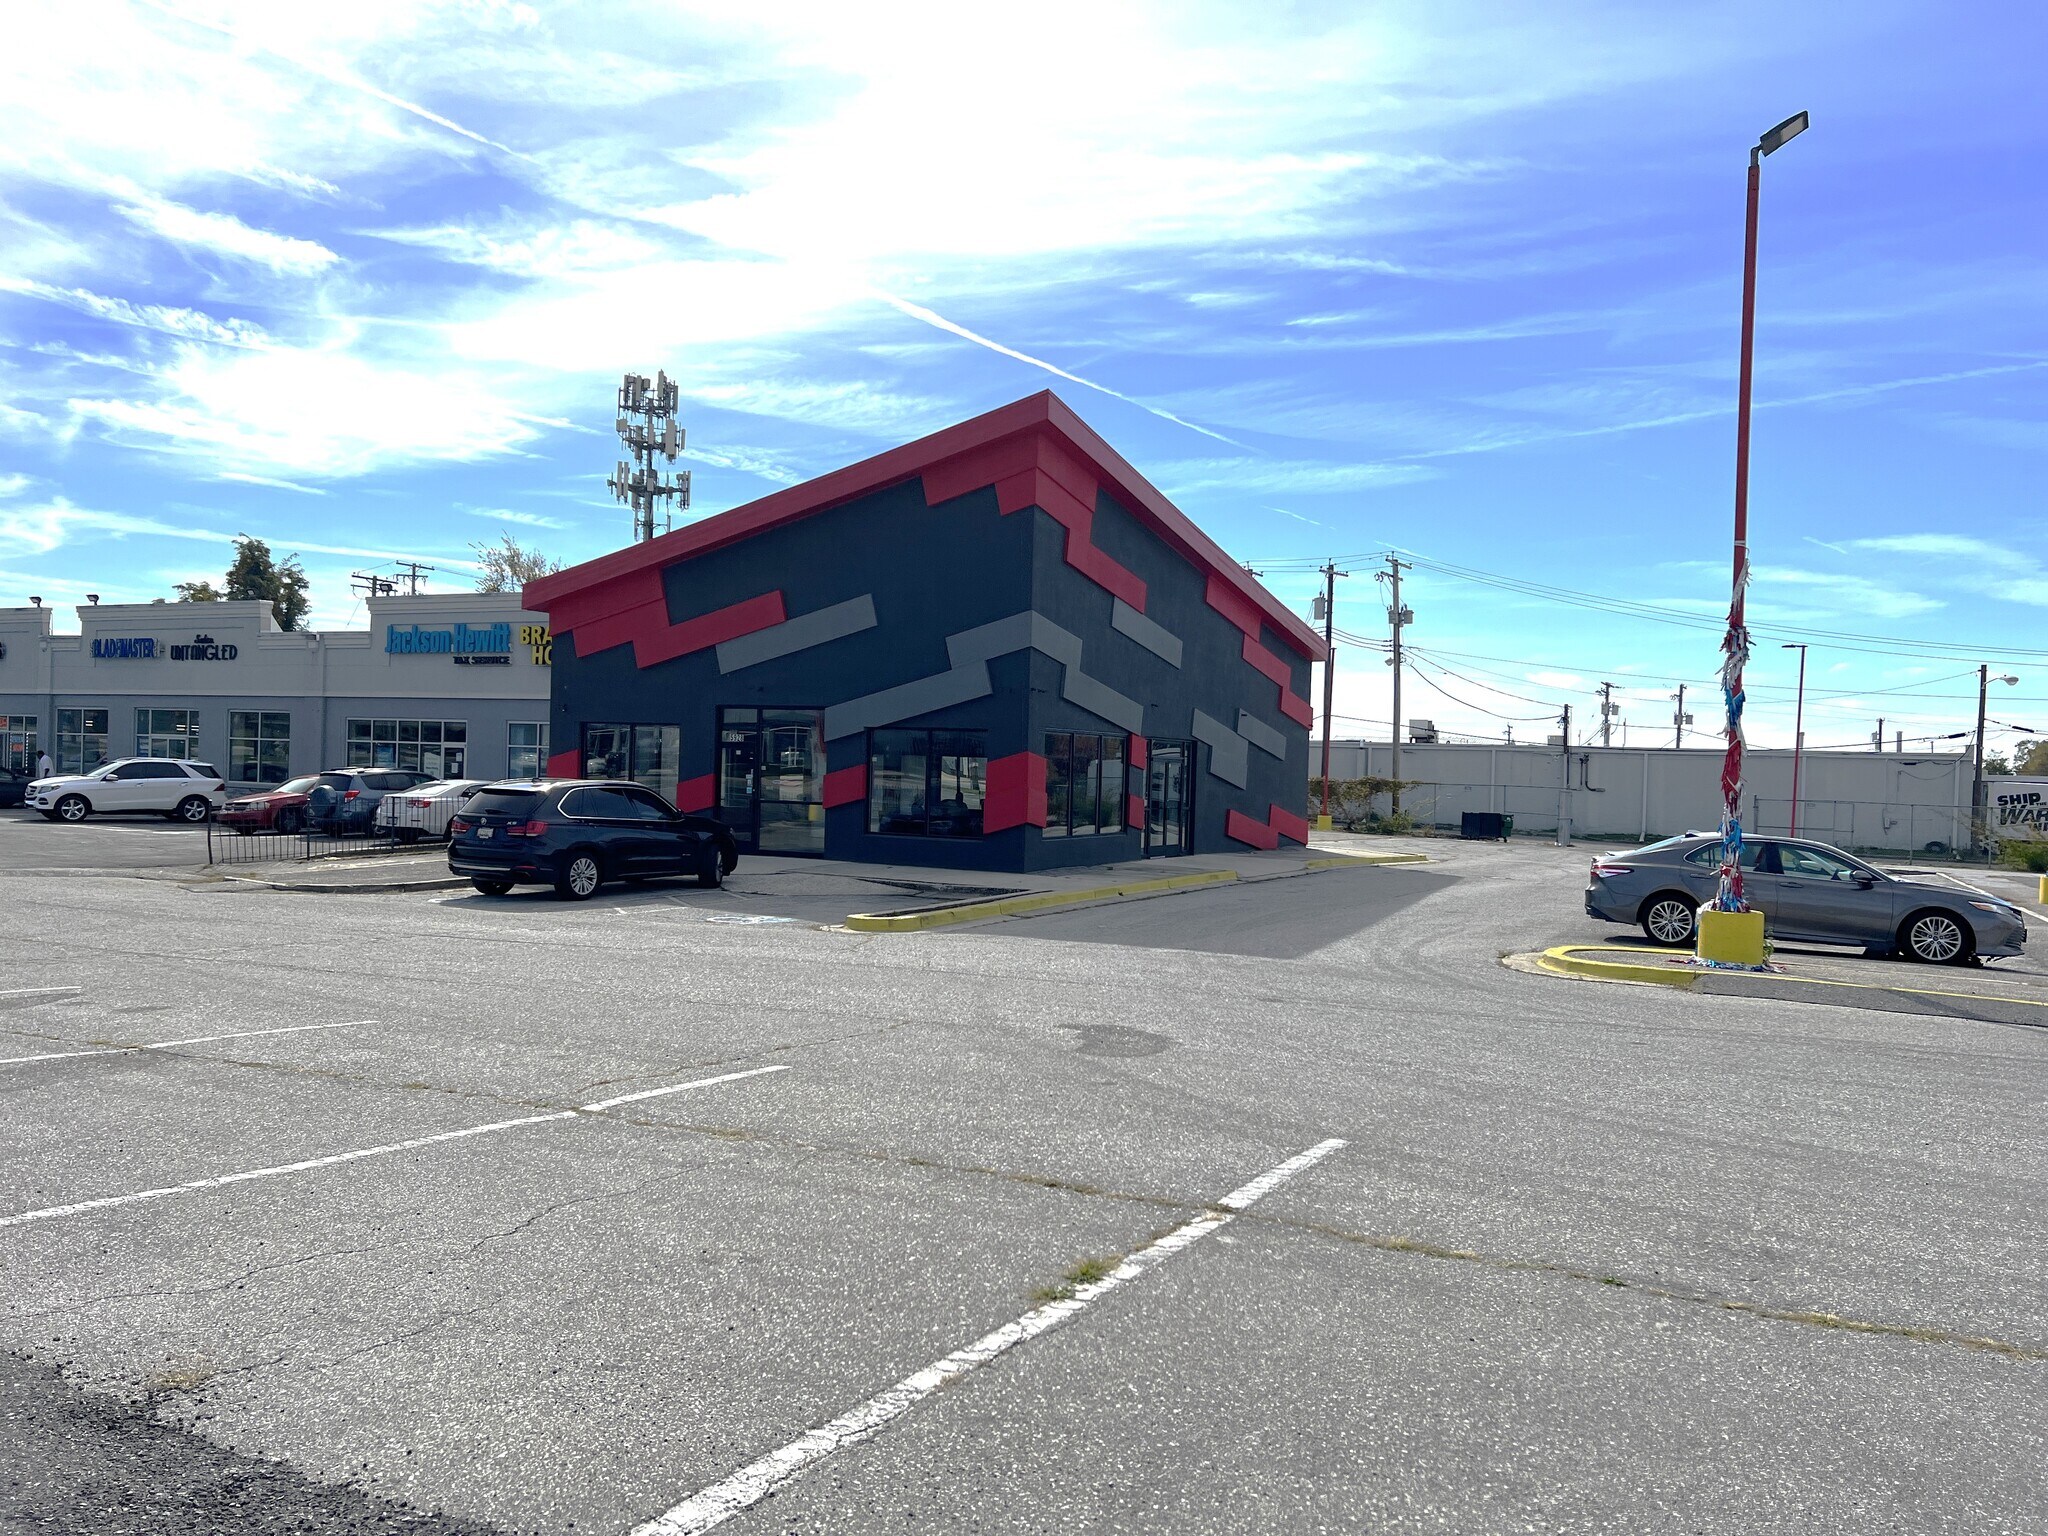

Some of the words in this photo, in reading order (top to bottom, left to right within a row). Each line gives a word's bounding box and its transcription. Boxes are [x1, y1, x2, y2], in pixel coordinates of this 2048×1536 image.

[385, 624, 451, 653] Jackson
[453, 623, 510, 653] Hewitt
[471, 656, 511, 665] SERVICE
[1997, 793, 2041, 806] SHIP
